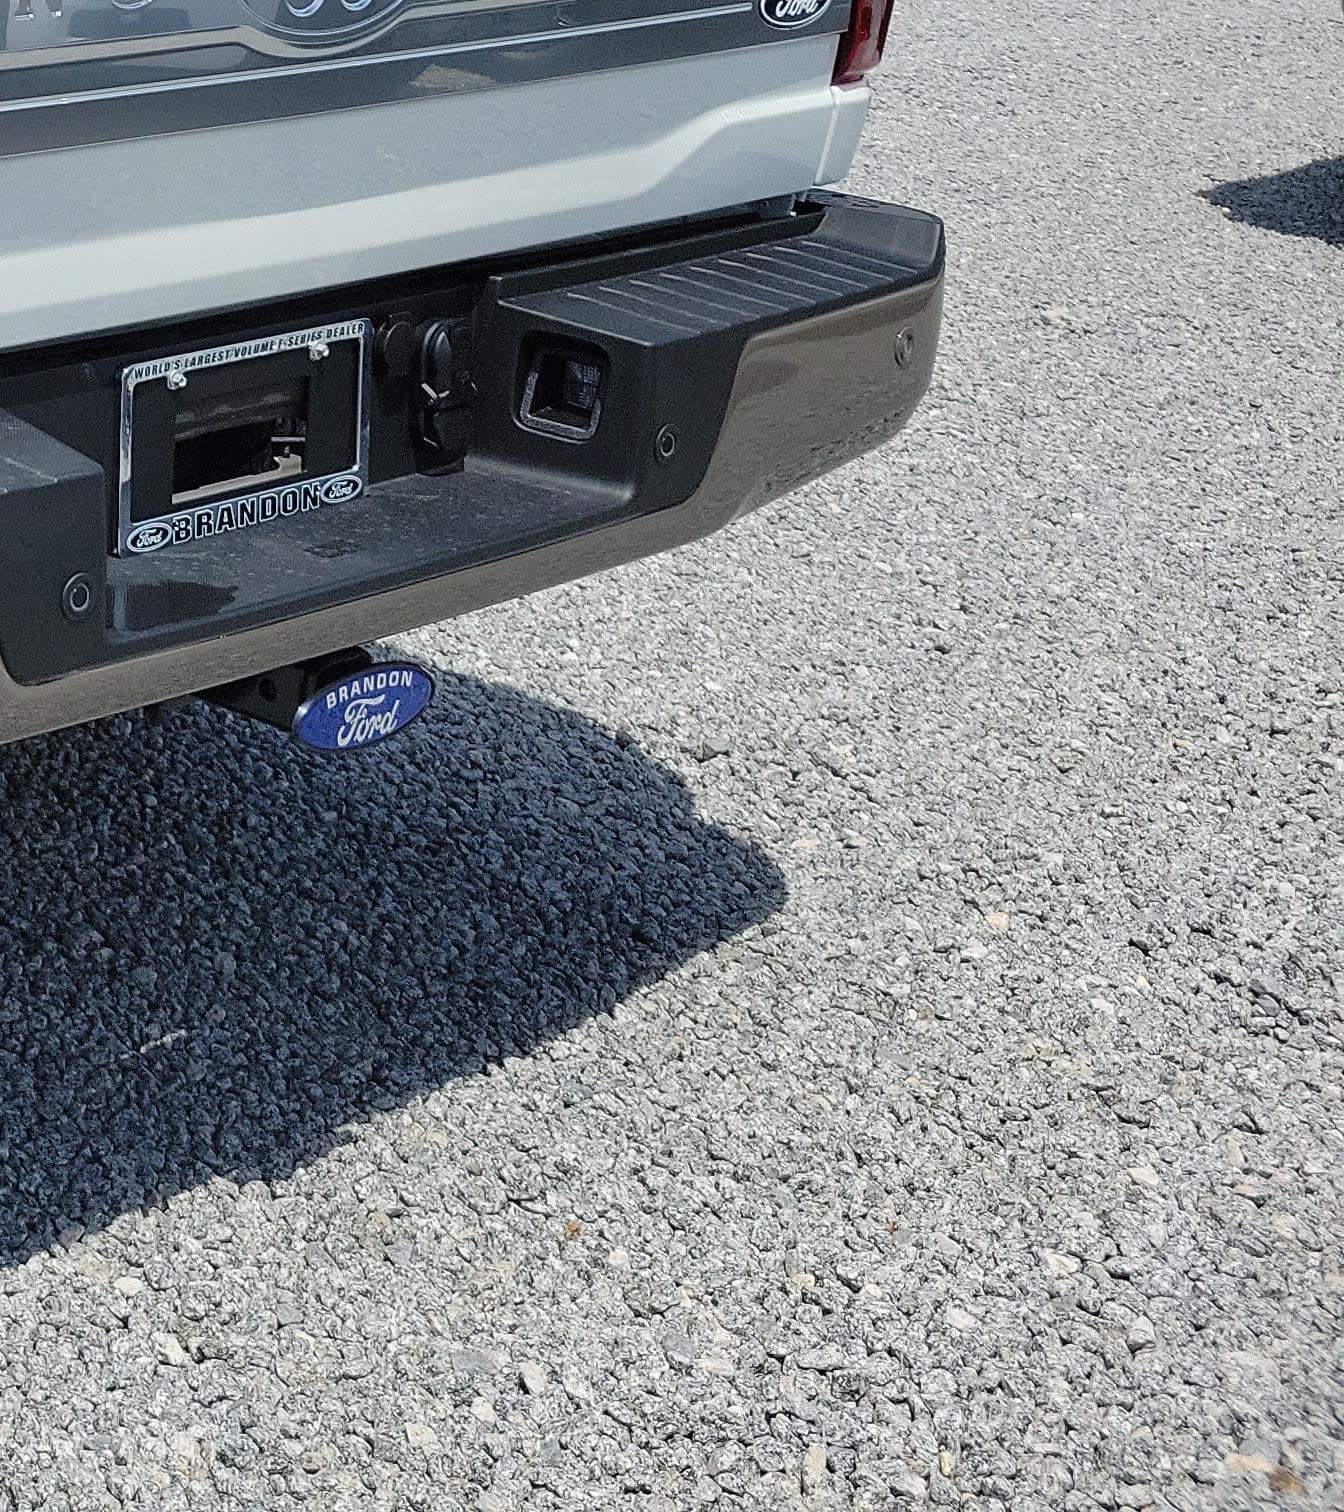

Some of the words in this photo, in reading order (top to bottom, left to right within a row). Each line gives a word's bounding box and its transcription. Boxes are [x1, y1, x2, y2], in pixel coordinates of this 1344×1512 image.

[134, 359, 181, 379] WORLD'S
[184, 349, 234, 368] LARGEST
[234, 341, 275, 358] VOLUME
[326, 322, 365, 339] DEALER
[172, 482, 321, 545] BRANDON
[325, 670, 413, 710] BRANDON
[337, 694, 401, 747] Ford
